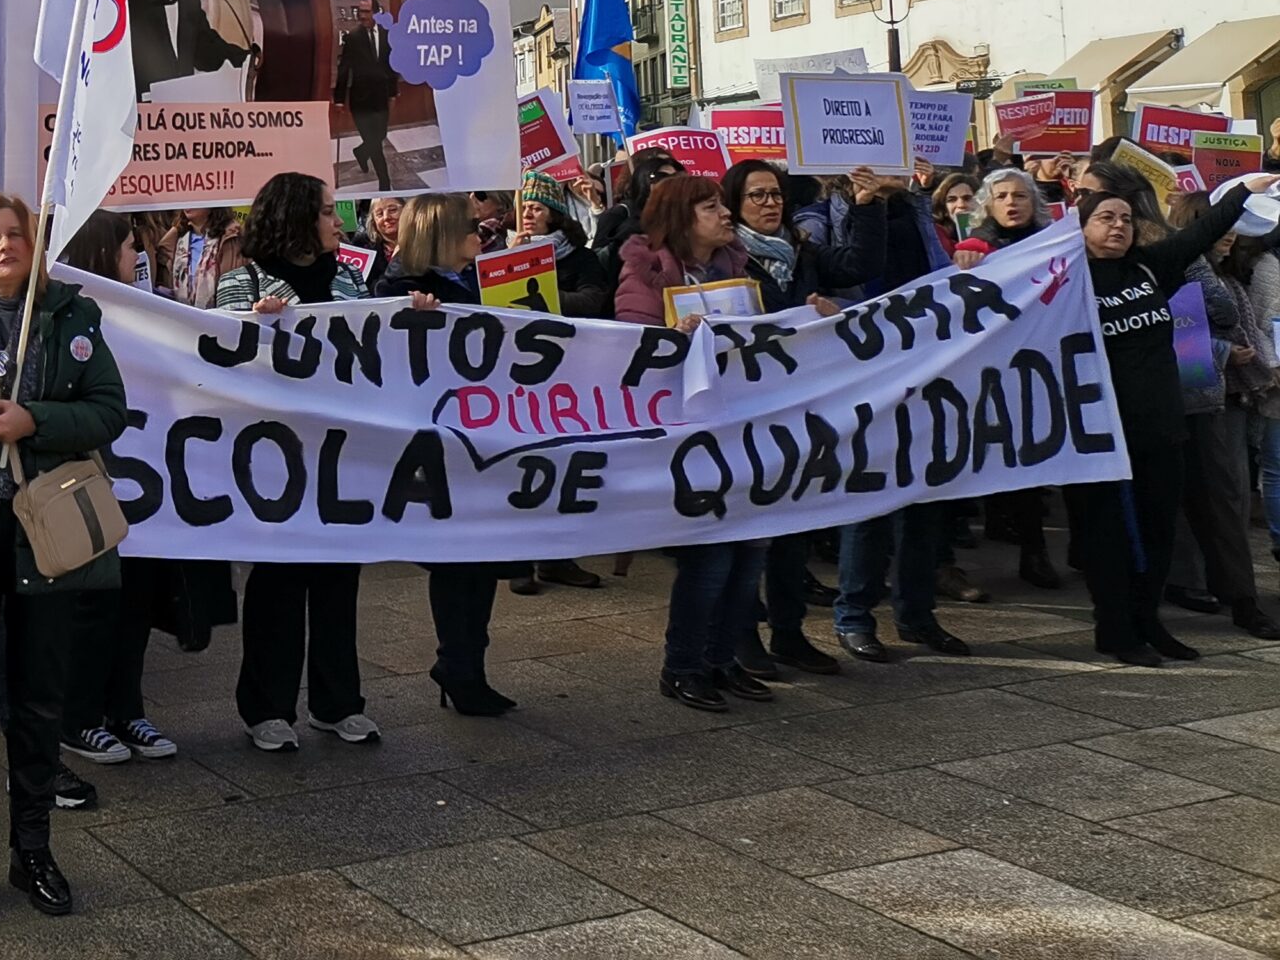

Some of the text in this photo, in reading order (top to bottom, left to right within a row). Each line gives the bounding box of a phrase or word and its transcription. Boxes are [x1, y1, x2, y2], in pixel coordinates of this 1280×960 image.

[408, 14, 477, 34] Antes na
[417, 45, 452, 66] TAP
[823, 98, 861, 117] DIREITO
[937, 102, 948, 112] DE
[999, 101, 1053, 120] RESPEITO
[148, 108, 304, 132] LÁ QUE NÃO SOMOS
[933, 113, 953, 123] PARA
[822, 127, 885, 145] PROGRESSÃO
[1203, 137, 1248, 147] JUSTIÇA
[165, 142, 187, 161] DA
[1215, 158, 1240, 167] NOVA
[120, 170, 235, 195] ESQUEMAS!!!
[1123, 281, 1154, 301] DAS
[198, 308, 576, 387] JUNTOS
[834, 273, 1021, 362] UMA
[1102, 307, 1170, 337] QUOTAS
[507, 451, 608, 513] DE
[670, 332, 1115, 520] QUALIDADE
